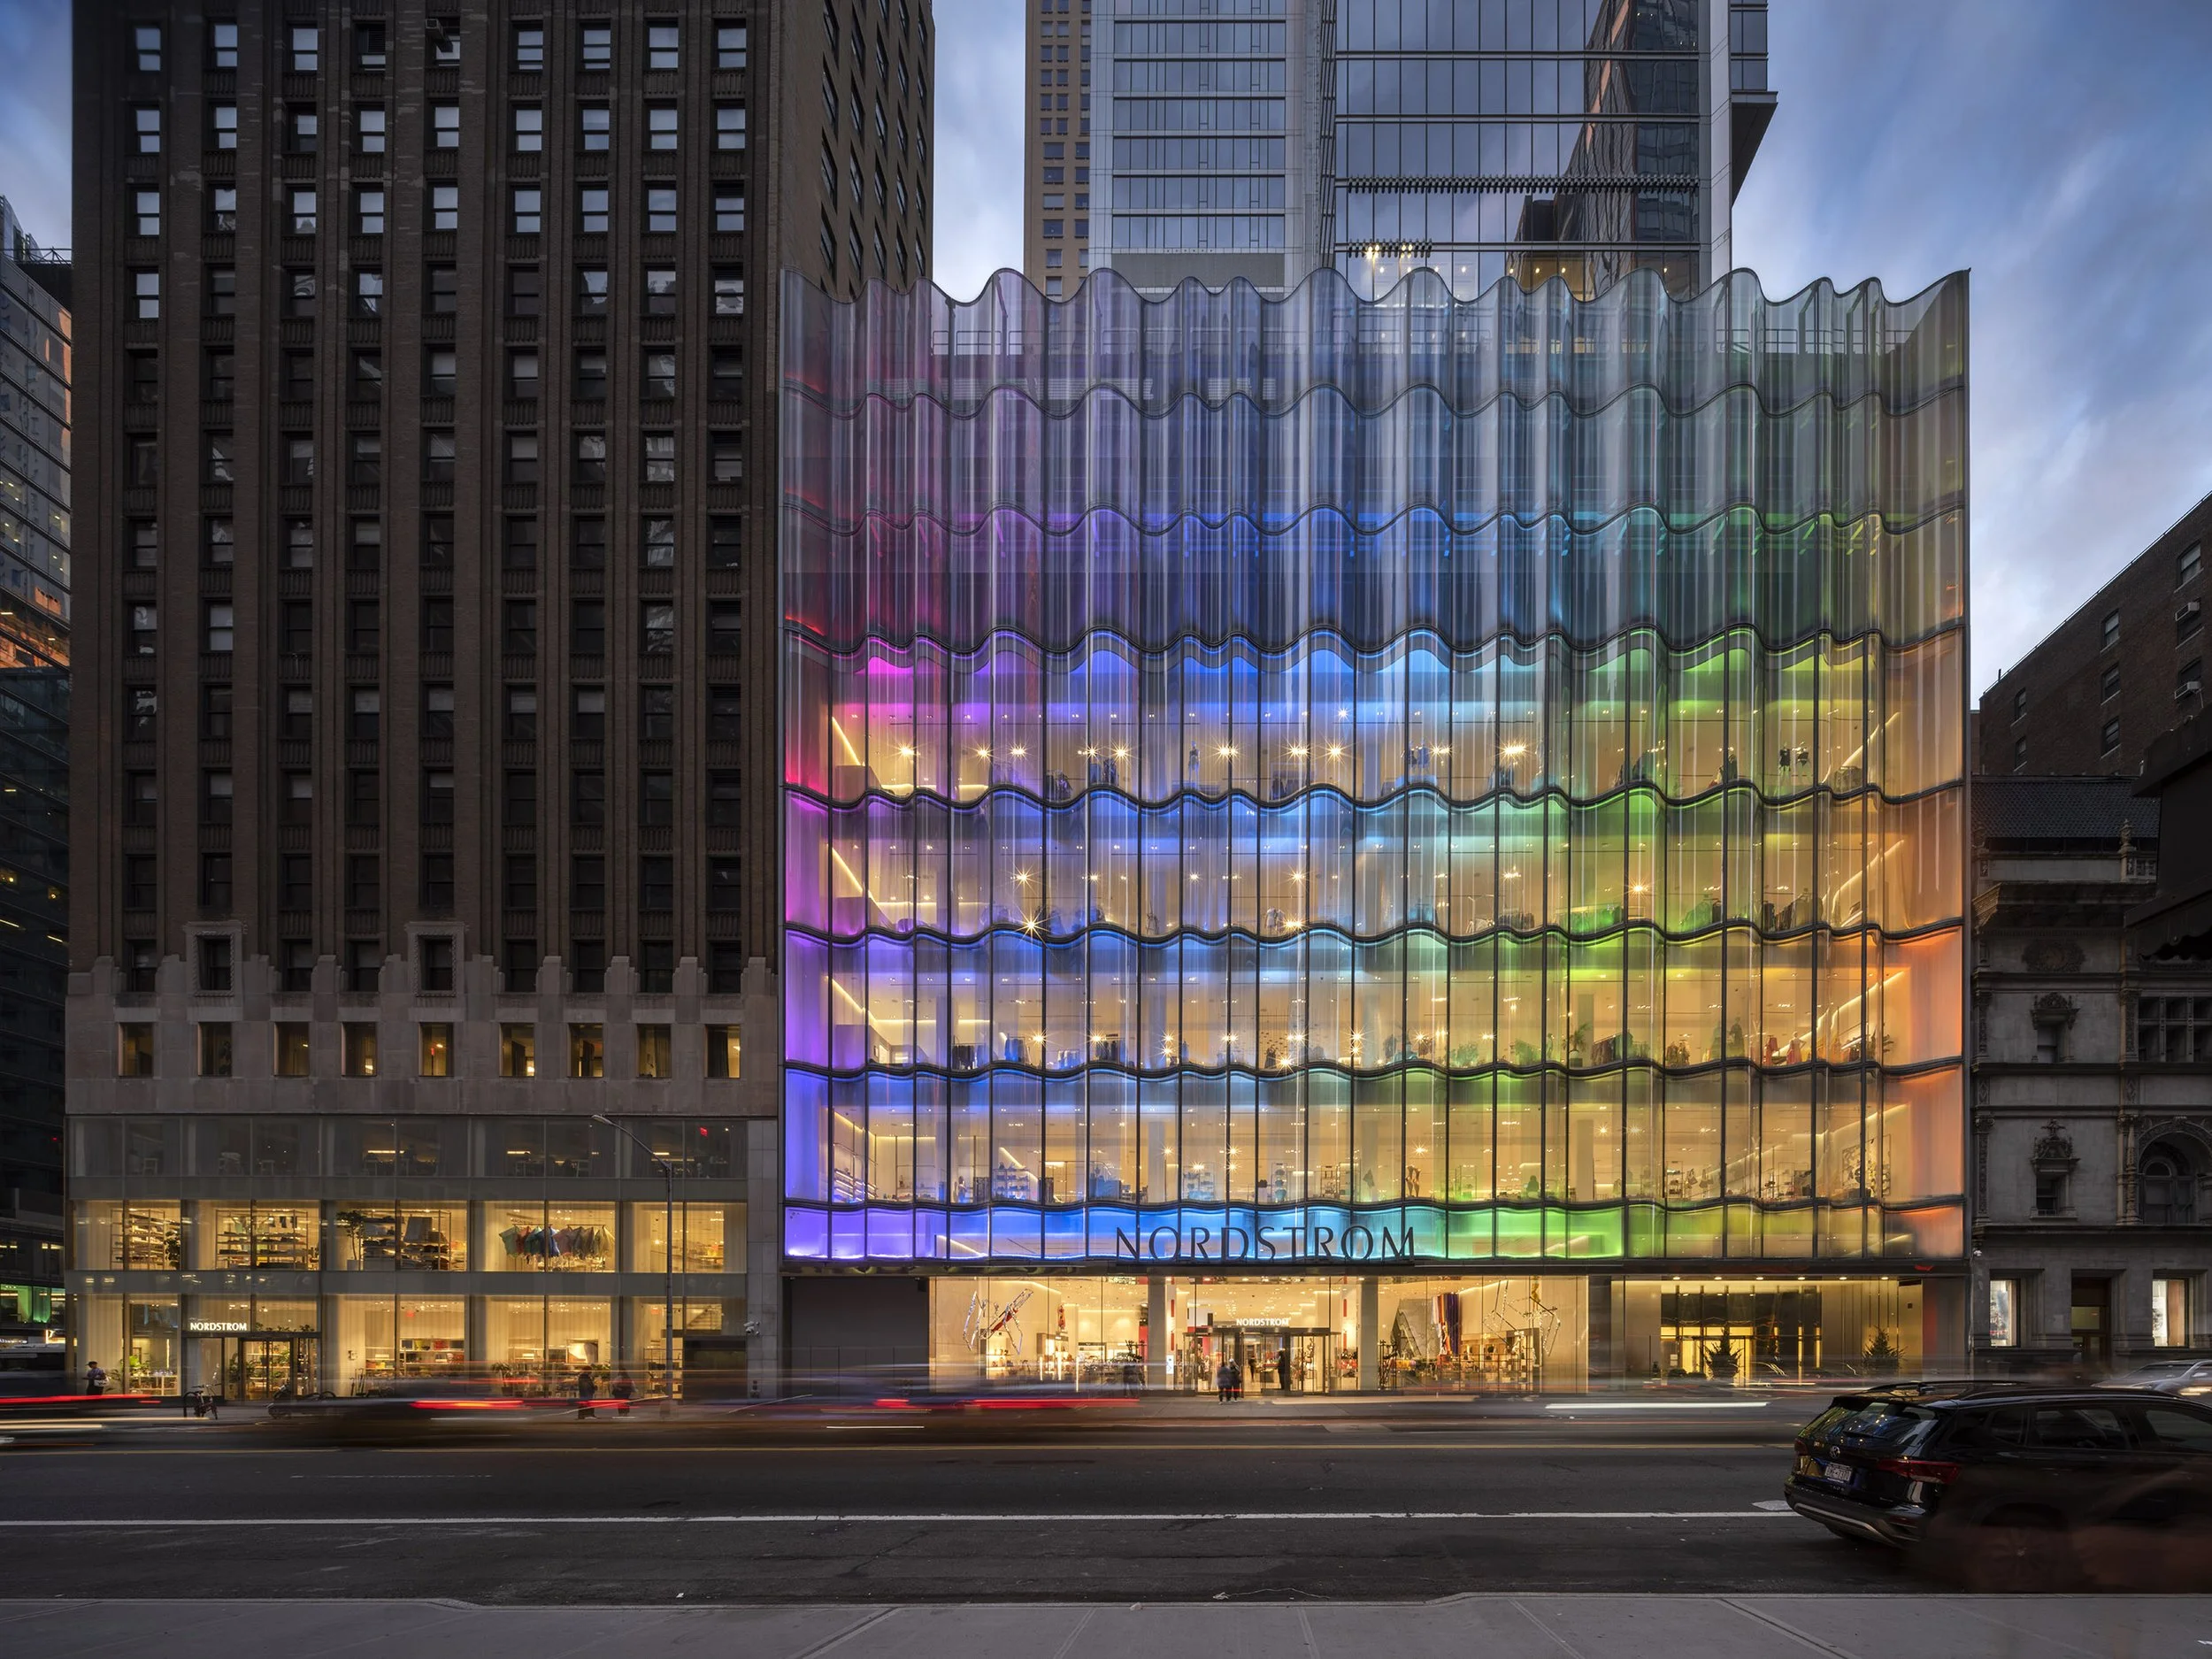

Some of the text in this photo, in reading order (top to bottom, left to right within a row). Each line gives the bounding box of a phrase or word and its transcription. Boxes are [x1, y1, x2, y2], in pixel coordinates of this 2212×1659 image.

[1116, 1225, 1415, 1262] NORDSTROM
[1236, 1317, 1289, 1326] NORDSTROM
[189, 1322, 247, 1331] NORDSTROM
